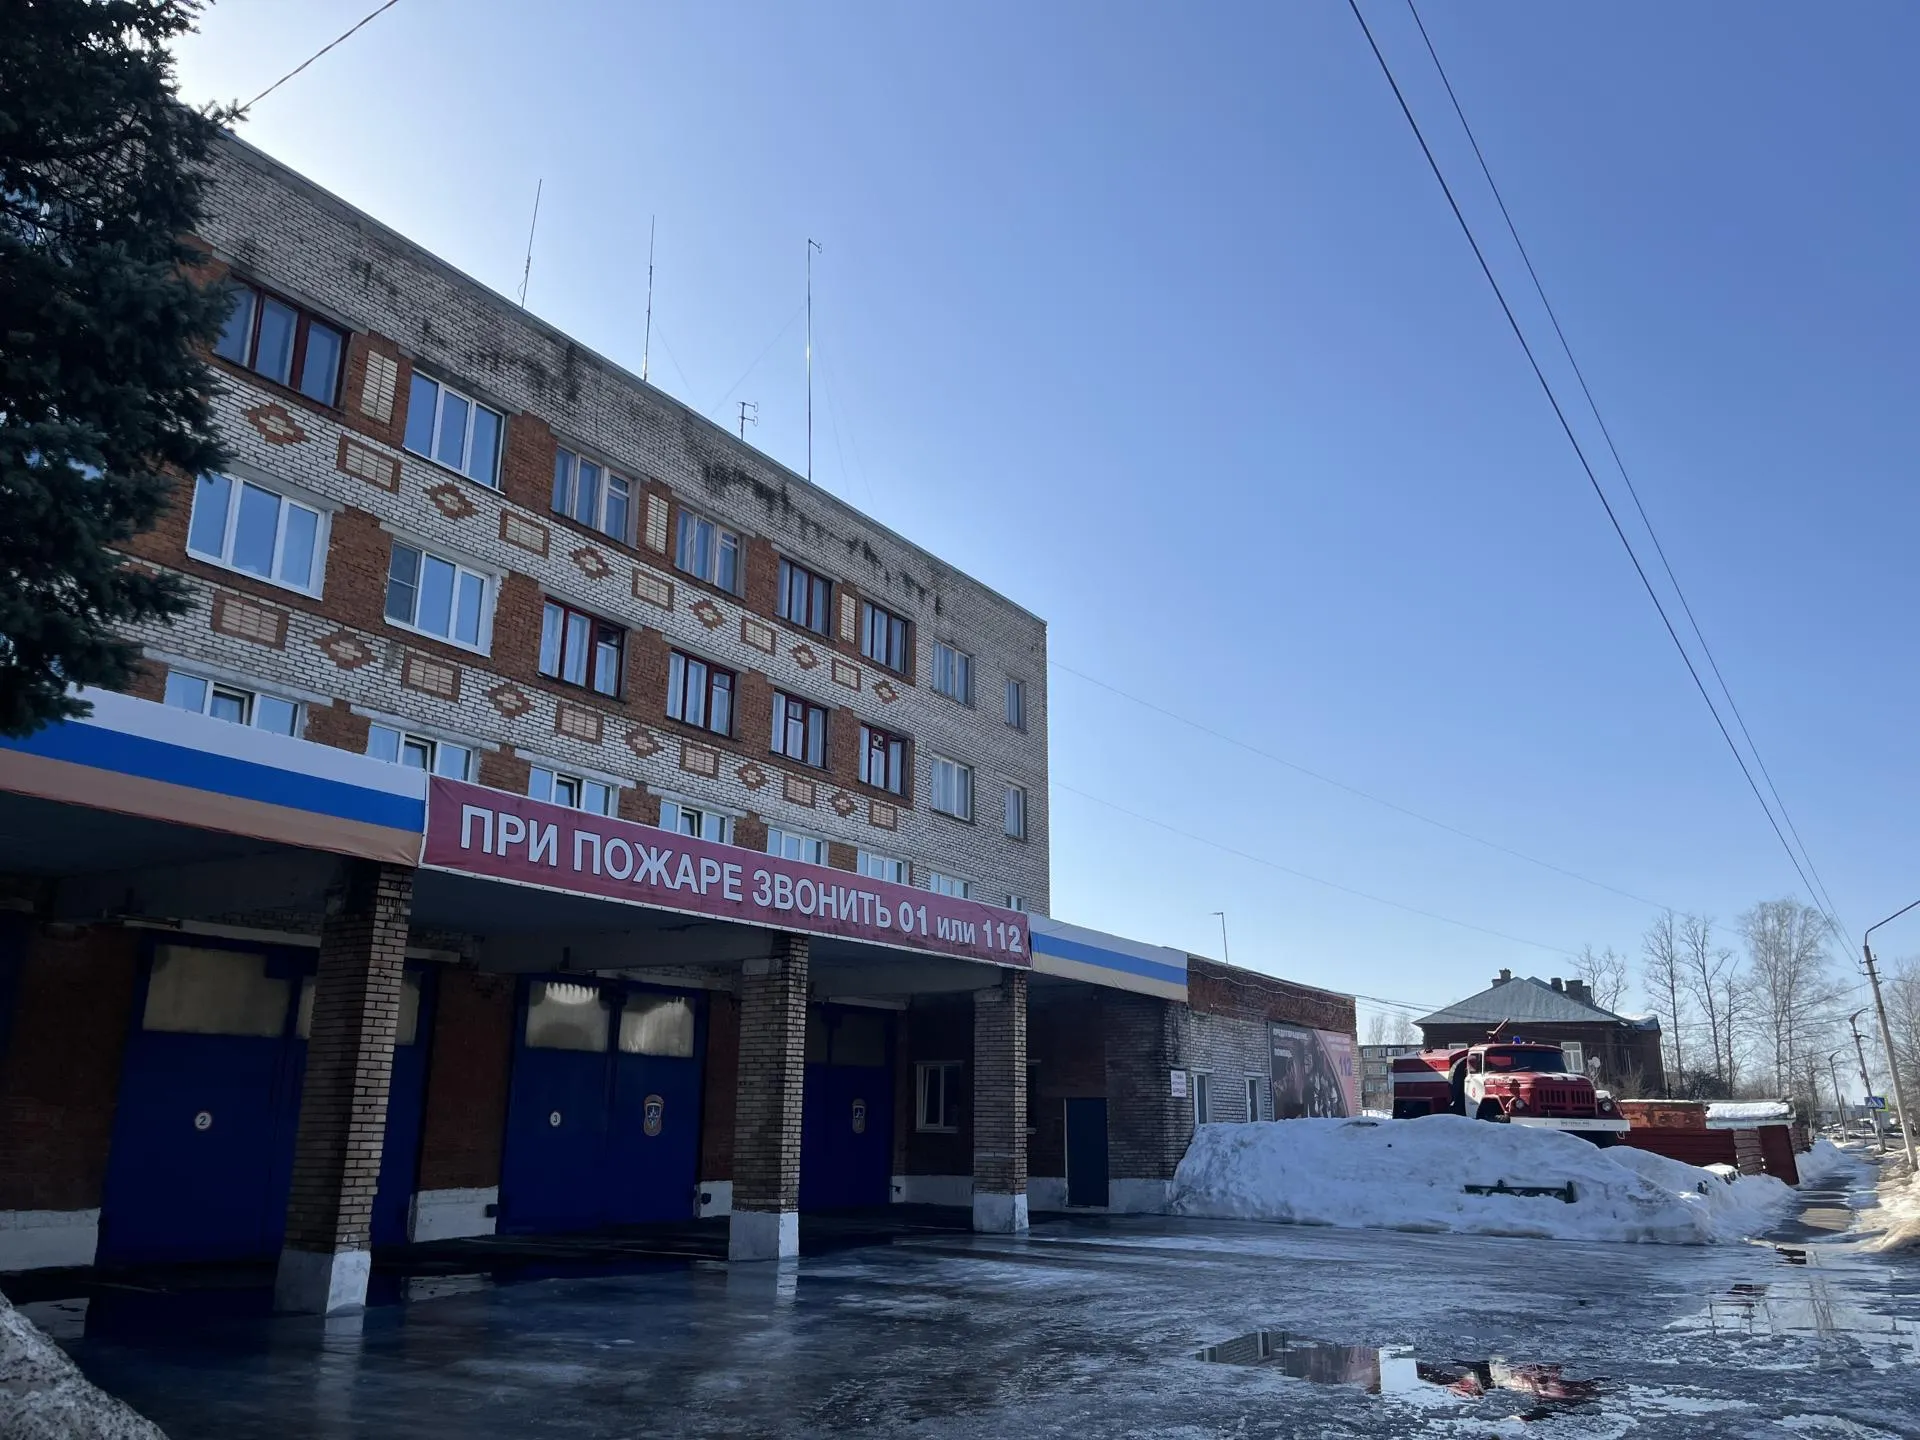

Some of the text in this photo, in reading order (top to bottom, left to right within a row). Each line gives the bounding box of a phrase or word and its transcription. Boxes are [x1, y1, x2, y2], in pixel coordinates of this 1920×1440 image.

[460, 804, 558, 867] ПРИ
[573, 829, 743, 902] ПОЖАРЕ
[752, 869, 892, 928] ЗВОНИТЬ
[899, 901, 928, 936] 01
[982, 919, 1022, 953] 112
